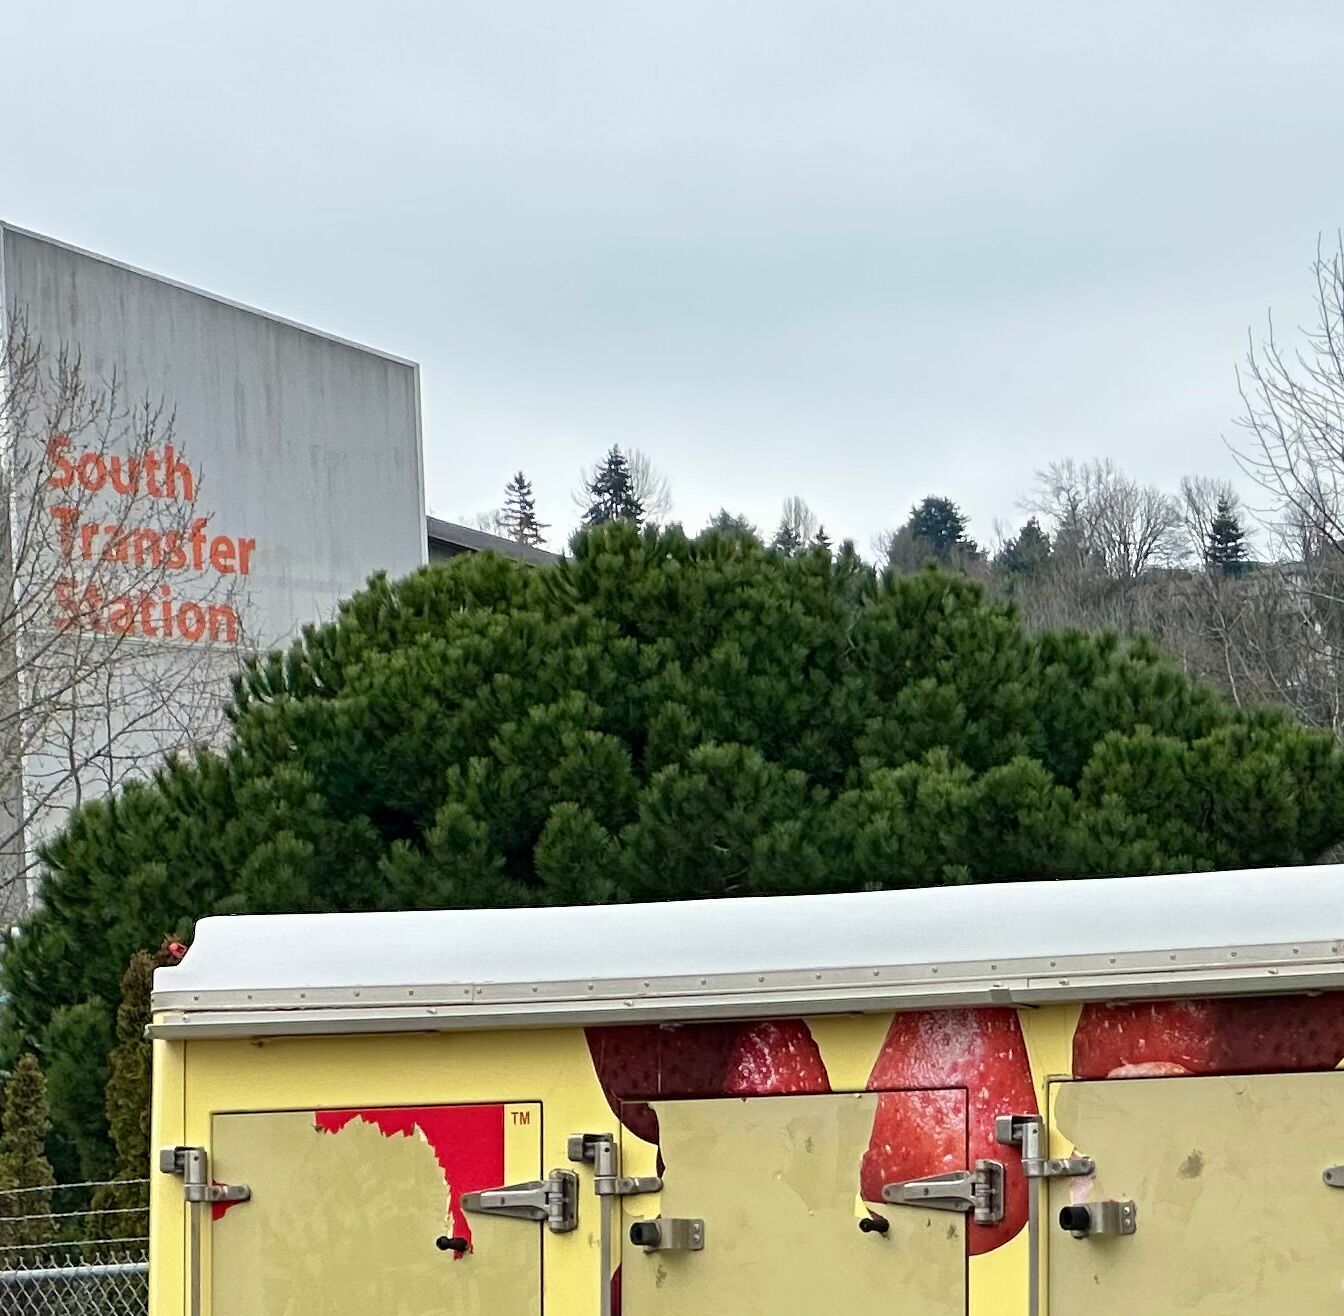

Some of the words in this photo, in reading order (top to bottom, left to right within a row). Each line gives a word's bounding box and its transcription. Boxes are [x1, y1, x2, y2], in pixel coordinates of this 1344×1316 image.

[47, 434, 195, 501] South
[51, 506, 256, 575] Transfer
[52, 577, 239, 643] Station
[511, 1111, 530, 1125] TM
